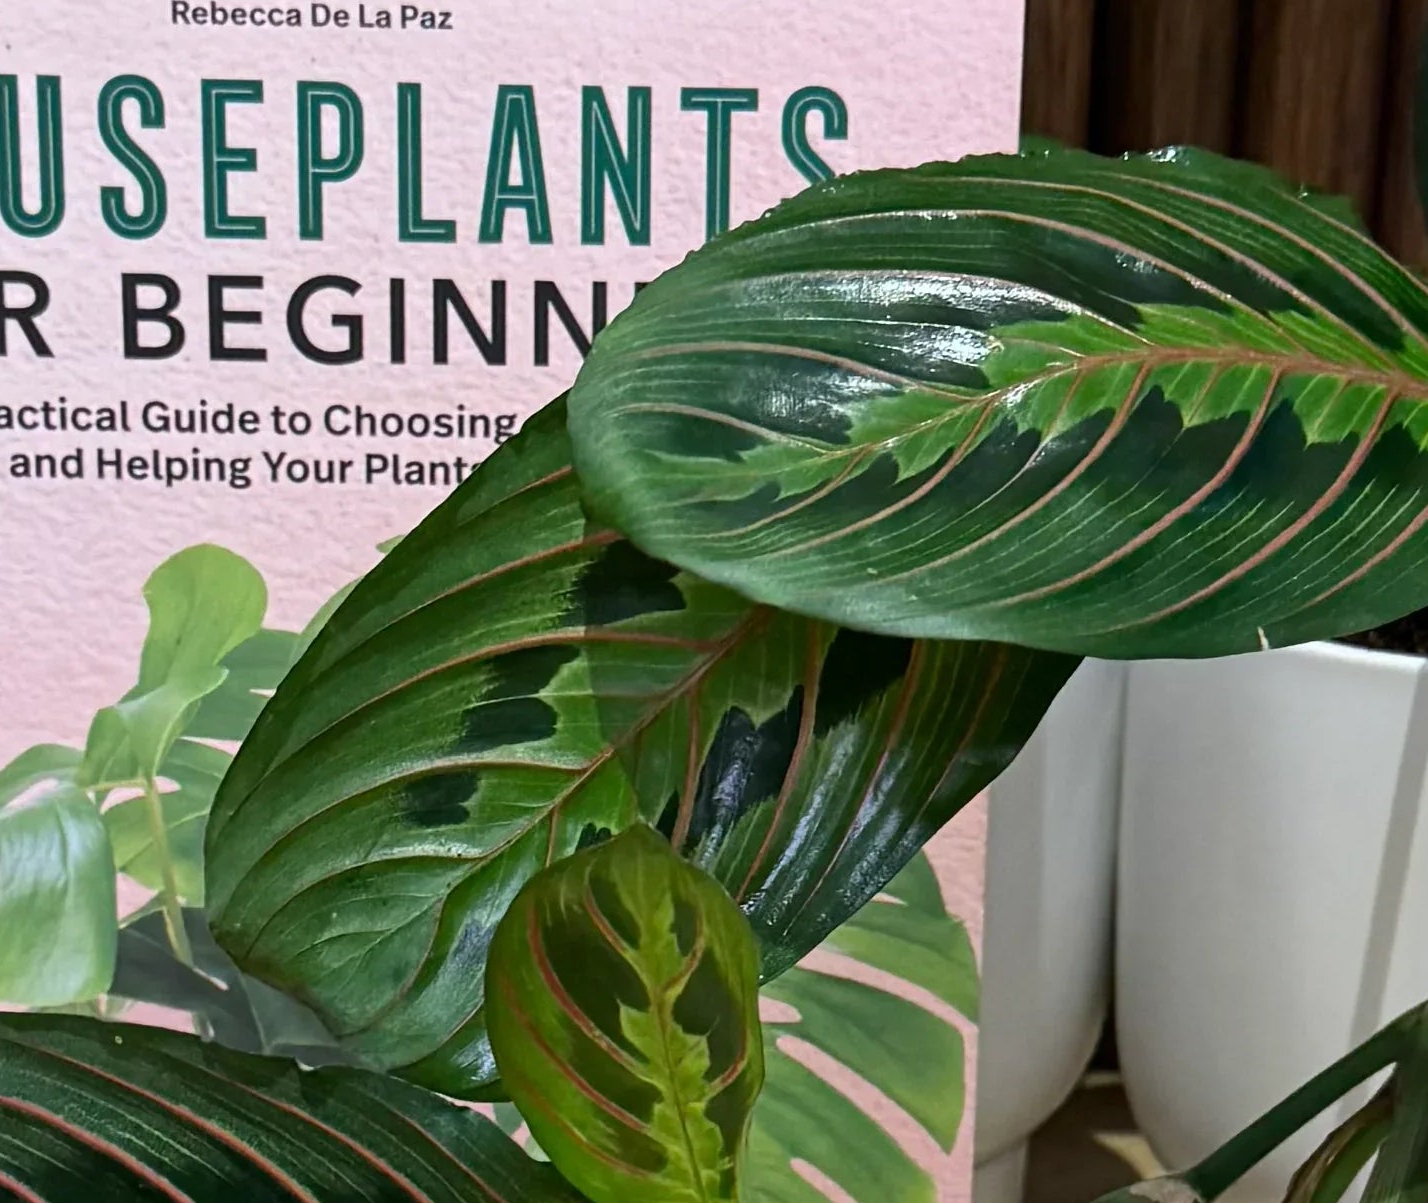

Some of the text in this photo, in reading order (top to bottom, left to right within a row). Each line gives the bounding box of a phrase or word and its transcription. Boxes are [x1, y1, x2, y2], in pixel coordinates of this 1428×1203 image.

[171, 0, 453, 30] Rebecca De La Paz
[120, 273, 653, 367] BEGINN
[141, 399, 261, 435] Guide
[270, 405, 312, 436] to
[323, 404, 517, 445] Choosing
[9, 447, 483, 489] and Helping Your Plant
